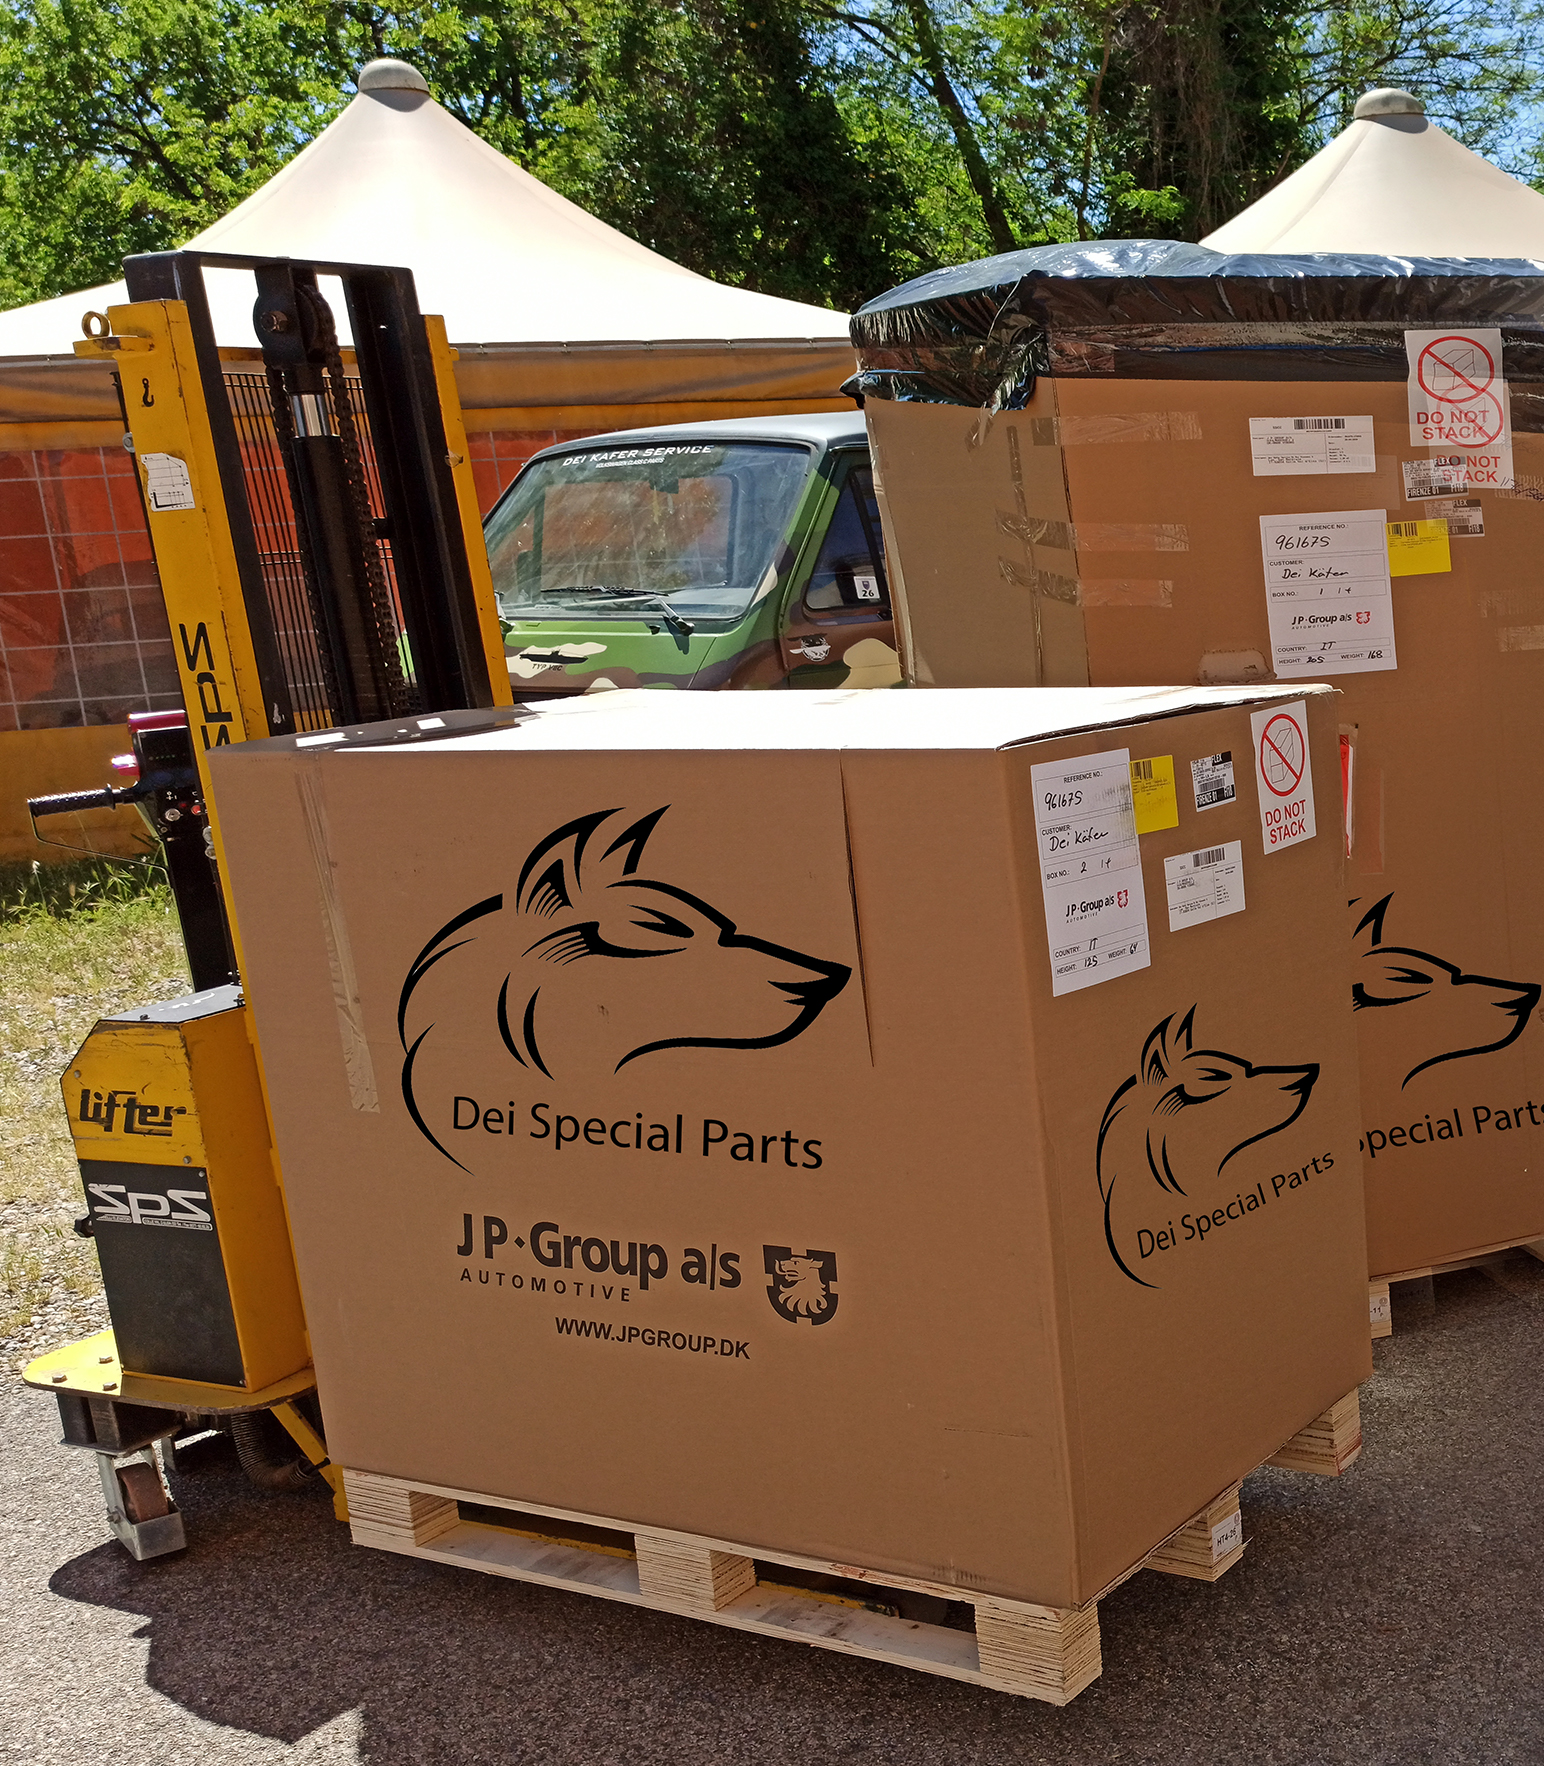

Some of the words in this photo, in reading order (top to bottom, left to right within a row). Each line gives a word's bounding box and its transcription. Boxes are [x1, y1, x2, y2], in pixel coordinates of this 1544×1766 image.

[1416, 411, 1445, 425] DO
[1450, 410, 1490, 424] NOT
[1422, 426, 1486, 440] STACK
[562, 456, 587, 467] DEI
[590, 449, 639, 463] KAFER
[642, 445, 715, 458] SERVICE
[1436, 454, 1461, 467] DO
[1466, 456, 1501, 468] NOT
[1442, 470, 1499, 483] STACK
[1063, 772, 1092, 783] REFERENCE
[1265, 808, 1282, 827] DO
[1284, 799, 1306, 821] NOT
[1269, 818, 1307, 844] STACK
[1046, 872, 1058, 880] BOX
[1055, 946, 1081, 958] COUNTRY:
[453, 1096, 516, 1136] Dei
[529, 1102, 683, 1154] Special
[702, 1118, 823, 1170] Parts
[1136, 1221, 1177, 1259] Dei
[1180, 1182, 1267, 1241] Special
[1270, 1151, 1335, 1198] Parts
[459, 1267, 631, 1303] AUTOMOTIVE
[555, 1316, 751, 1361] WWW.JPGROUP.DK
